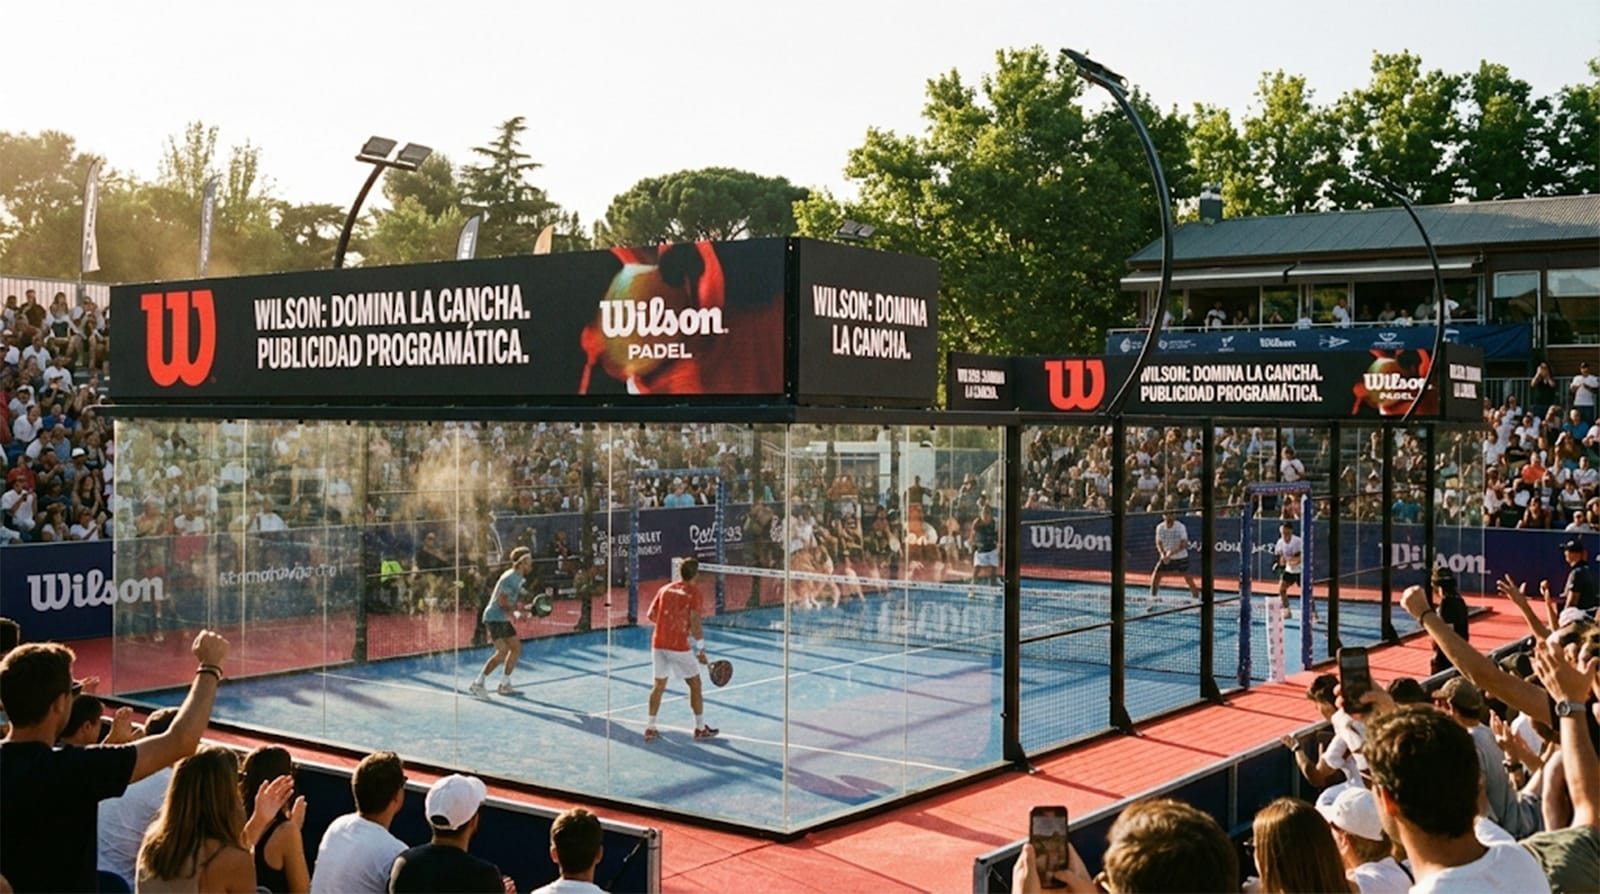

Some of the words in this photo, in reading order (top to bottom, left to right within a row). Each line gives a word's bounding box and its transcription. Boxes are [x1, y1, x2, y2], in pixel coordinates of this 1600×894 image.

[254, 296, 327, 331] WILSON:
[331, 291, 407, 327] DOMINA
[410, 289, 435, 324] LA
[438, 284, 531, 323] CANCHA.
[812, 284, 873, 322] WILSON:
[875, 293, 928, 328] DOMINA
[257, 334, 362, 369] PUBLICIDAD
[366, 321, 529, 366] PROGRAMÁTICA.
[628, 343, 692, 360] PADEL
[832, 324, 850, 355] LA
[852, 326, 911, 360] CANCHA.
[1141, 385, 1215, 402] PUBLICIDAD
[1217, 383, 1323, 402] PROGRAMÁTICA.
[1193, 365, 1244, 382] DOMINA
[1246, 364, 1263, 382] LA
[1264, 364, 1323, 382] CANCHA.
[27, 569, 164, 612] Wilson
